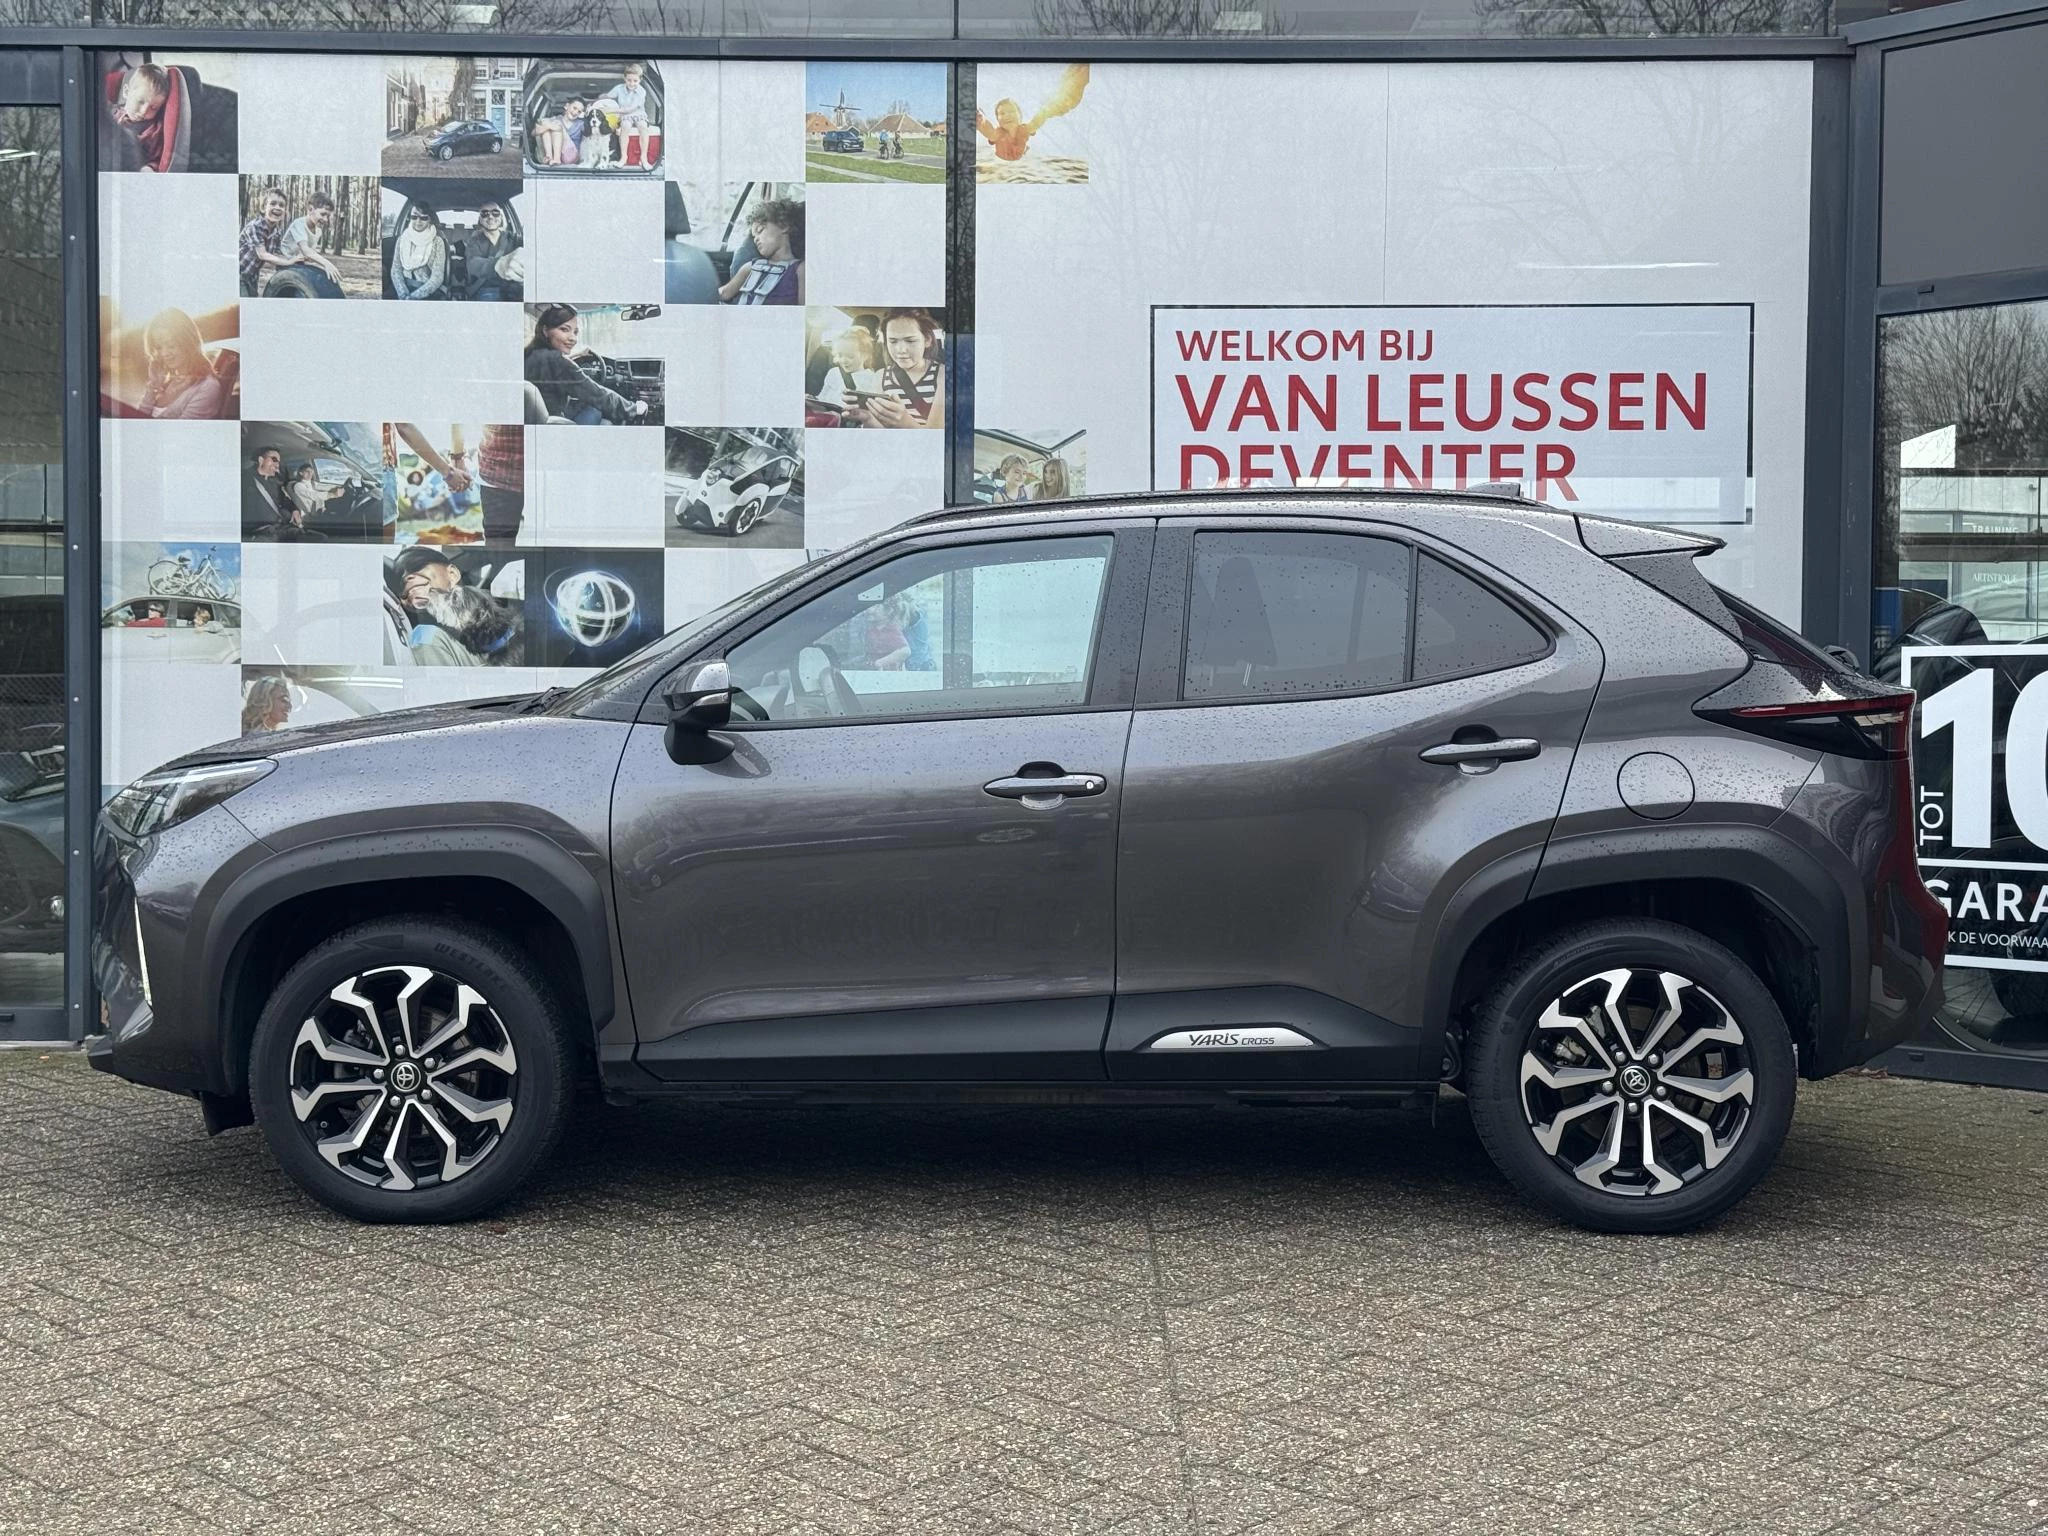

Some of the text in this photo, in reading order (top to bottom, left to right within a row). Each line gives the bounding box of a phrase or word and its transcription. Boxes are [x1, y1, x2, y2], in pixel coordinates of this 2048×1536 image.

[1175, 329, 1434, 362] WELKOM BIJ
[1175, 371, 1707, 432] VAN LEUSSEN
[1179, 443, 1580, 501] DEVENTER
[1919, 785, 1944, 846] TOT
[1959, 931, 1977, 945] DE
[1241, 1037, 1275, 1046] CROSS
